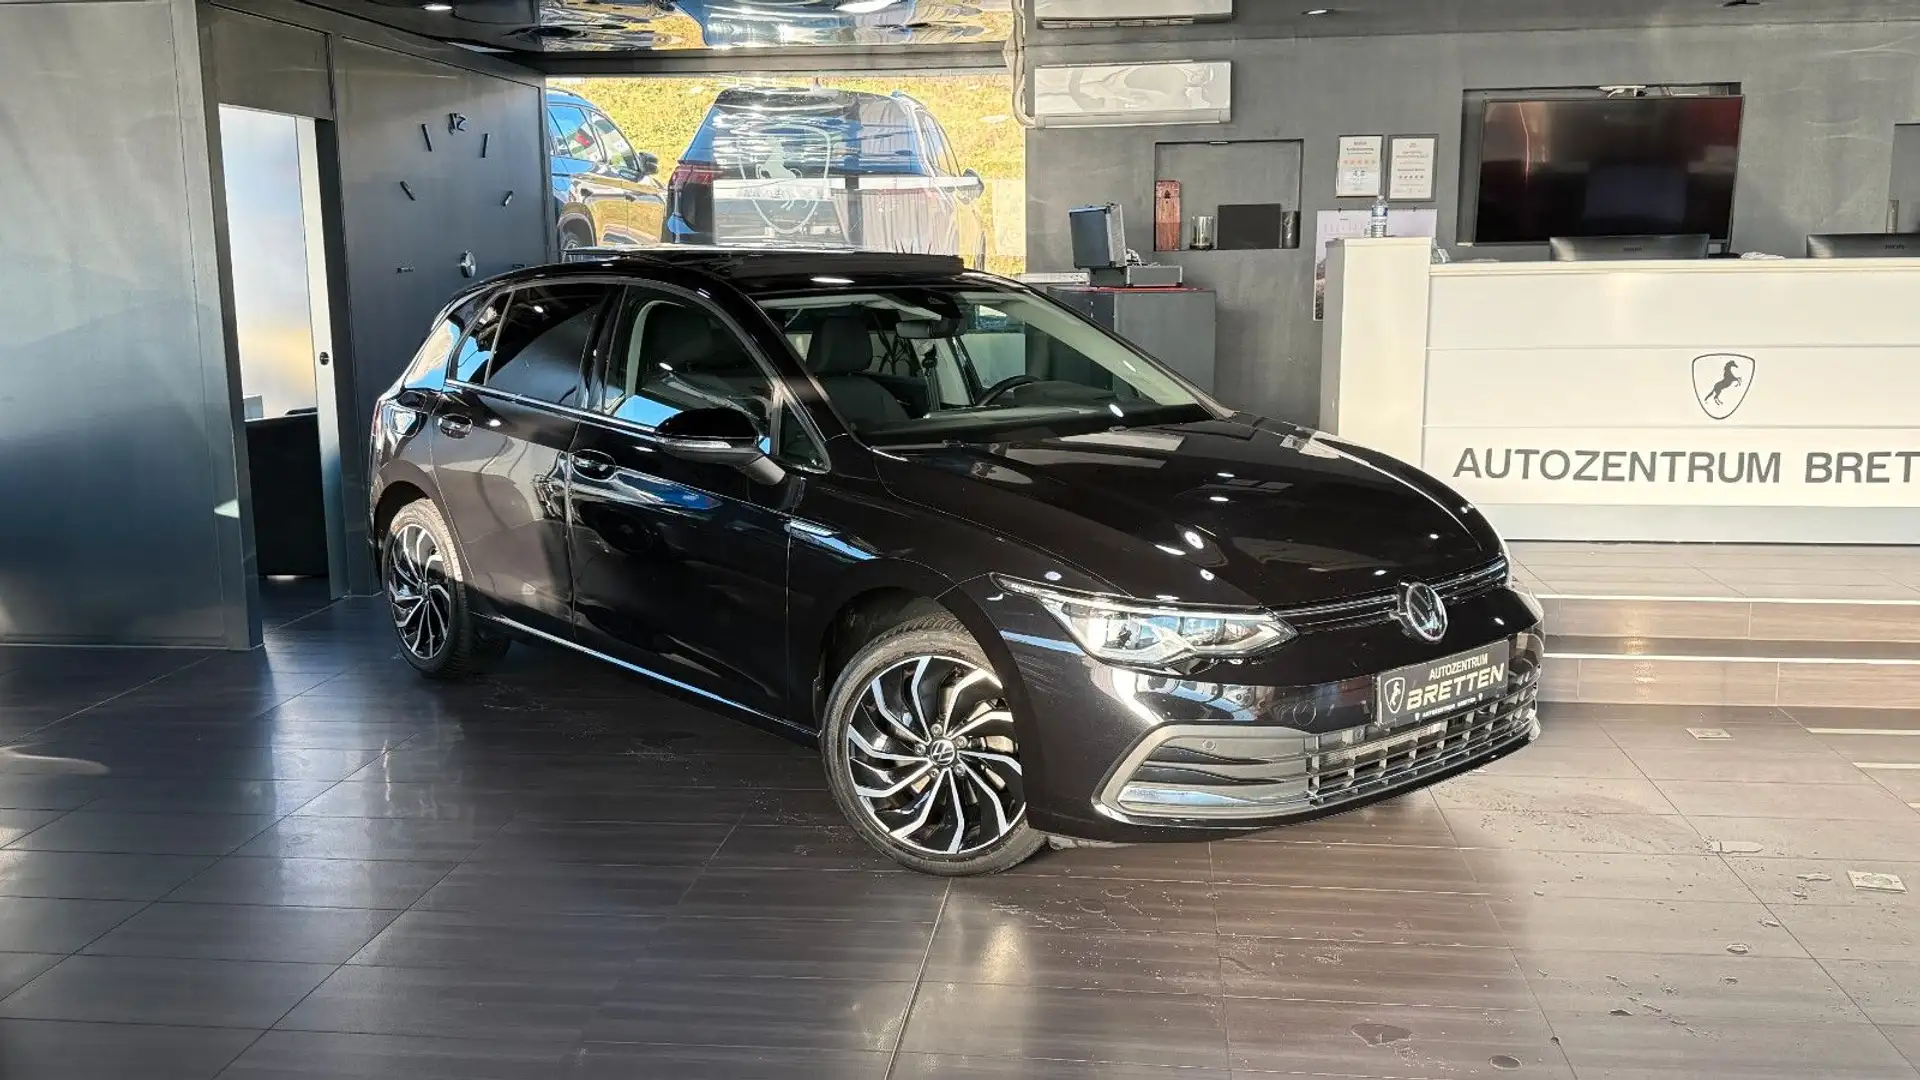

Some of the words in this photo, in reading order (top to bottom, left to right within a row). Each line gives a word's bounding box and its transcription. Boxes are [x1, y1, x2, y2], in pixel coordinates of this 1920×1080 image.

[1452, 447, 1781, 483] AUTOZENTRUM
[1805, 451, 1920, 483] BRET
[1429, 653, 1488, 681] AUTOZENTRUM
[1406, 662, 1504, 711] BRETTEN
